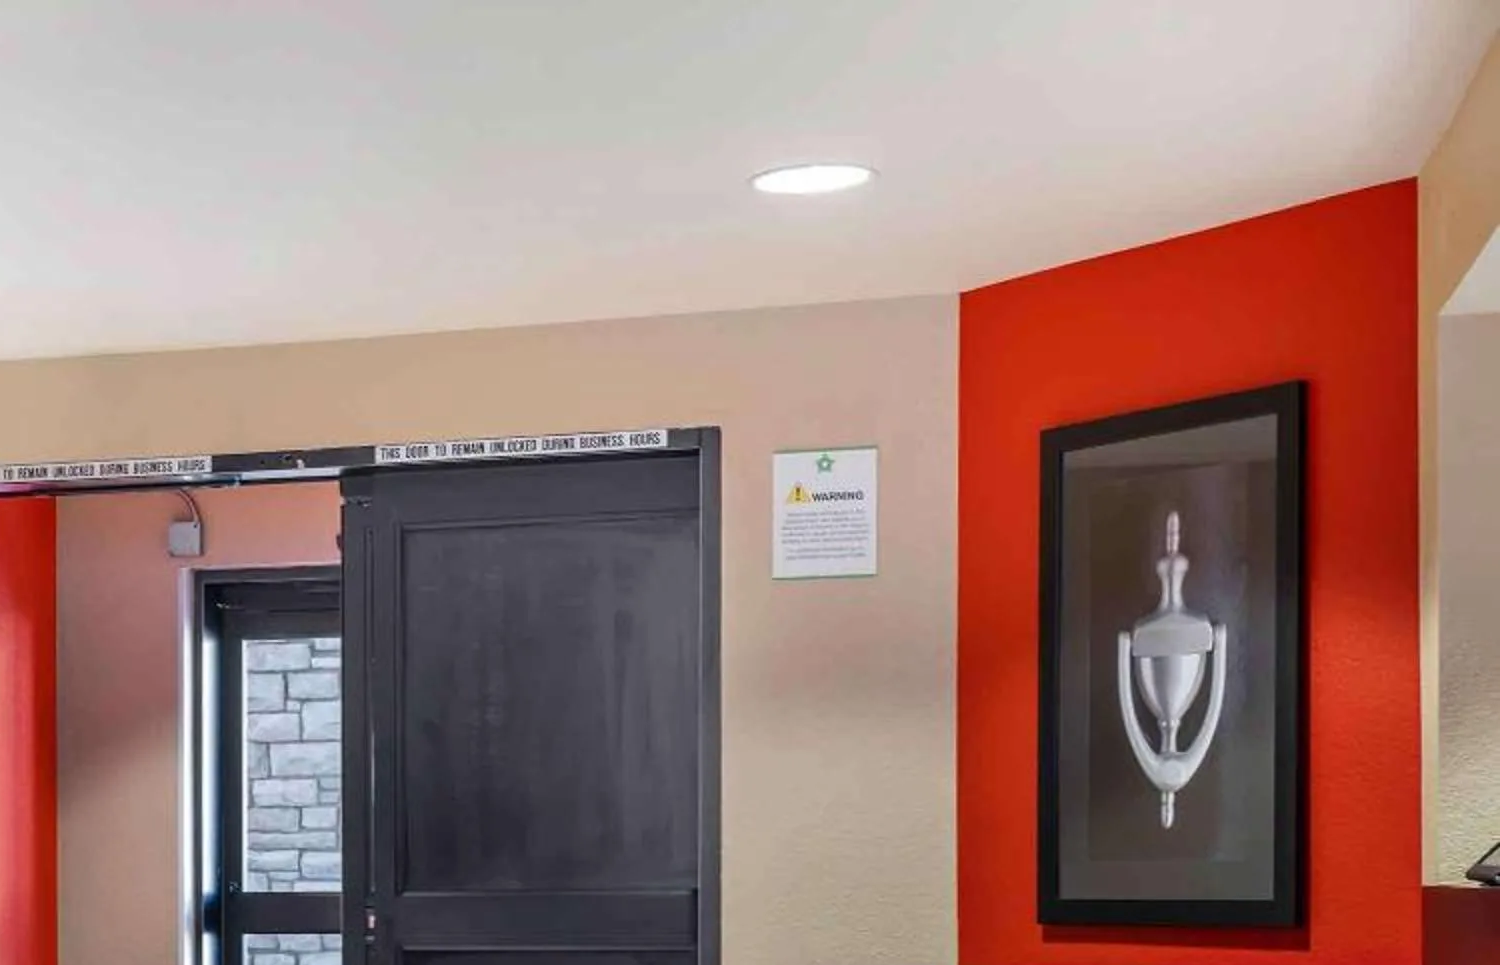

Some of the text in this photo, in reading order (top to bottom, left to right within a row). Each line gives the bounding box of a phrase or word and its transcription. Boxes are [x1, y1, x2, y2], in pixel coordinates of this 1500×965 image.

[380, 431, 660, 460] THIS DOOR TO REMAIN UNLOCKED DURING BUSINESS HOURS
[3, 467, 14, 480] TO
[18, 466, 48, 479] REMAIN
[53, 464, 95, 477] UNLOCKED
[134, 461, 173, 474] BUSINESS
[812, 490, 865, 502] WARNING
